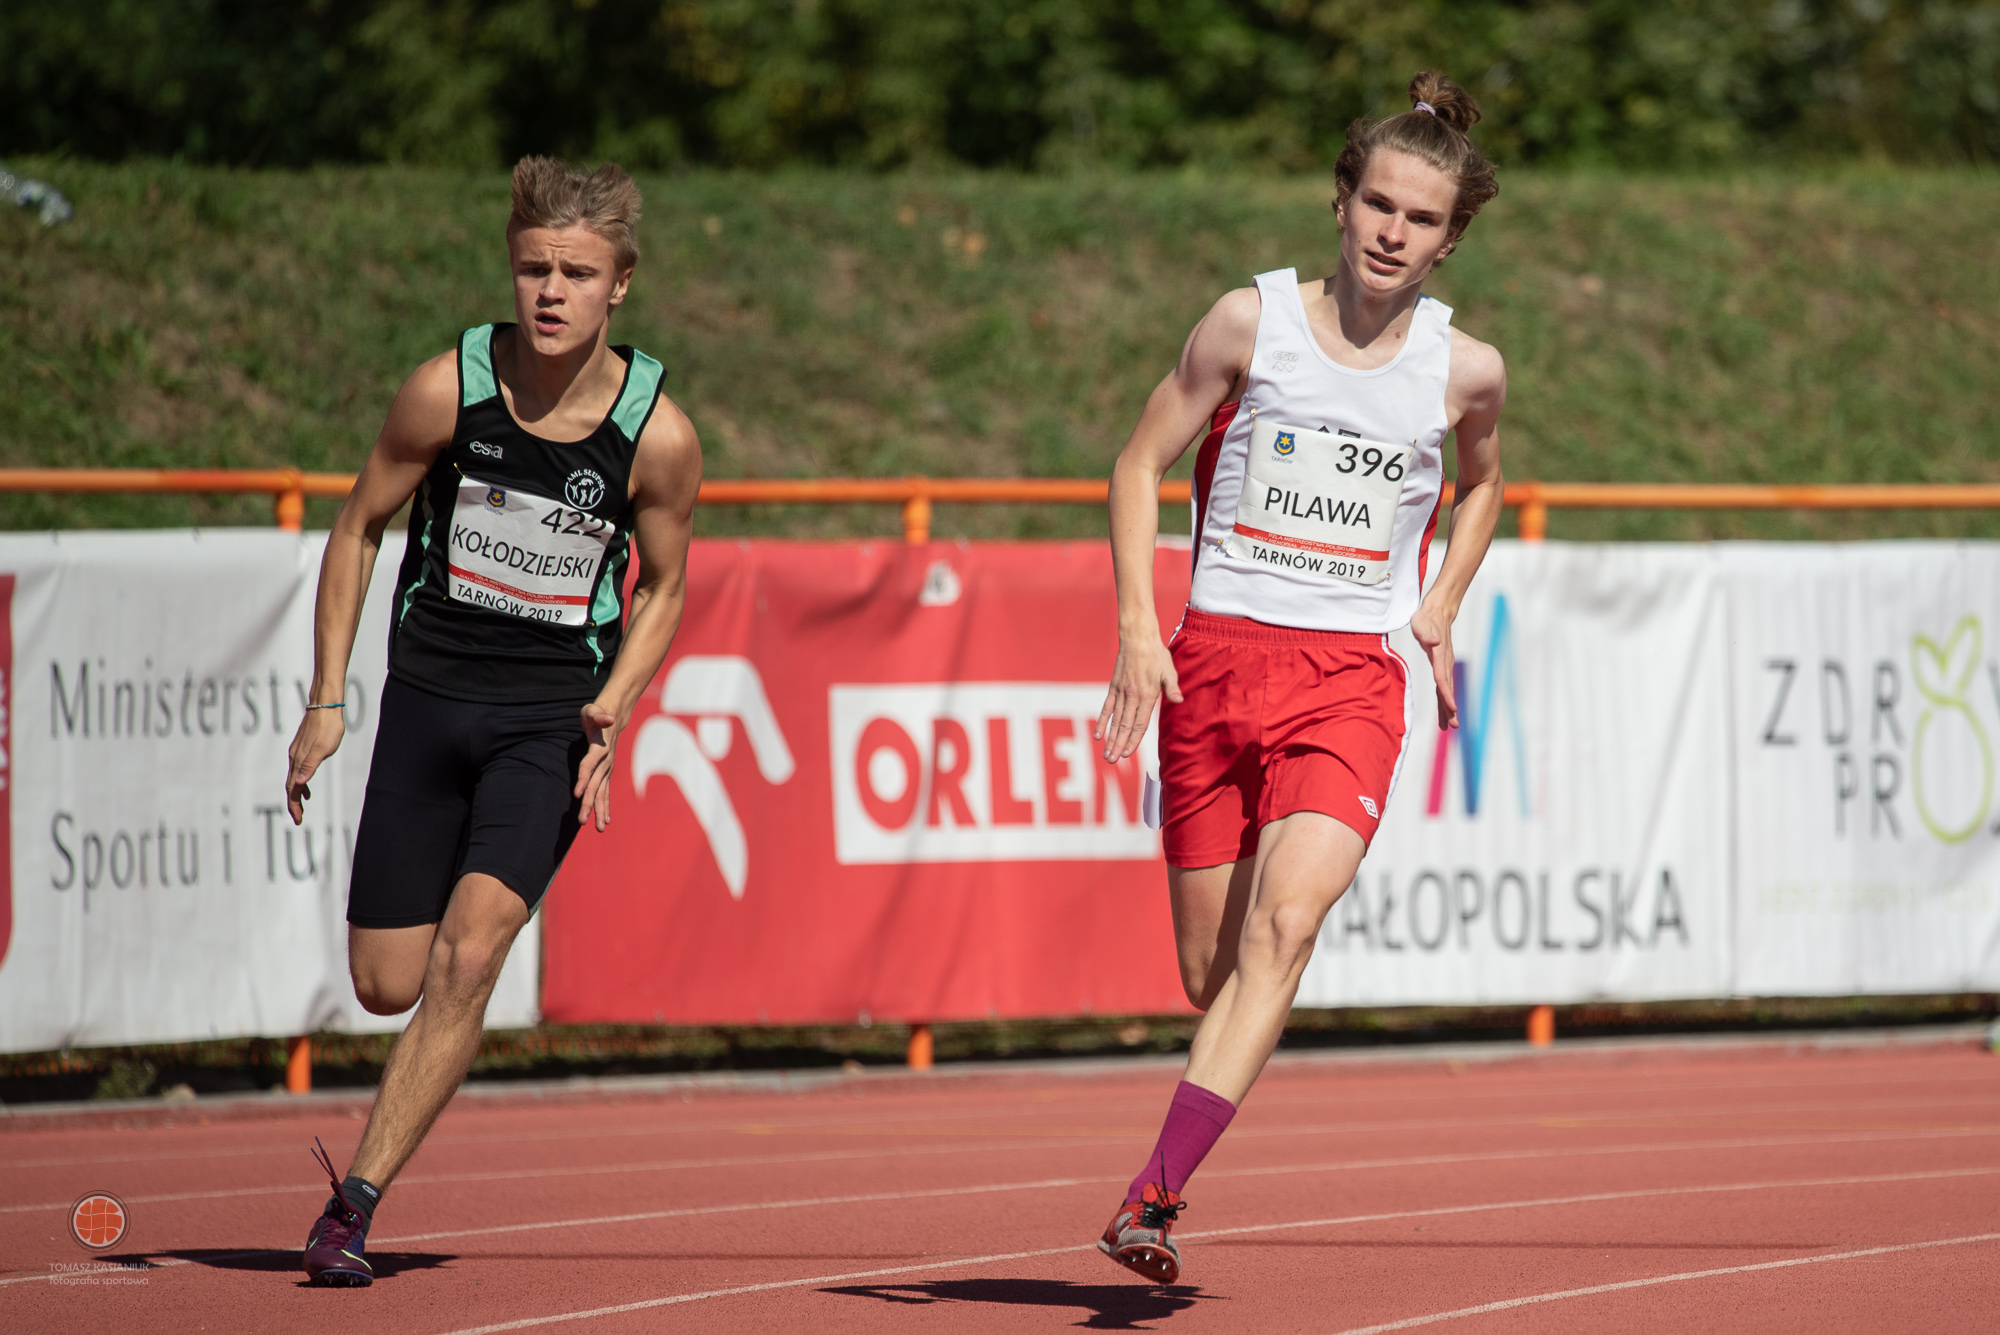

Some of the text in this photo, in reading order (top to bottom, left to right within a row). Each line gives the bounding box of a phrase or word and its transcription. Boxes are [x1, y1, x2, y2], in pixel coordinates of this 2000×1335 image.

[1335, 443, 1405, 482] 396
[540, 507, 607, 539] 422
[1264, 486, 1372, 529] PILAWA
[451, 523, 595, 579] KOŁODZIEJSKI
[1252, 545, 1366, 579] TARNÓW 2019
[457, 583, 563, 622] TARNÓW 2019
[853, 716, 1142, 835] ORLEN
[49, 810, 199, 912] Sportu
[221, 806, 232, 886] i
[1322, 865, 1691, 953] AŁOPOLSKA
